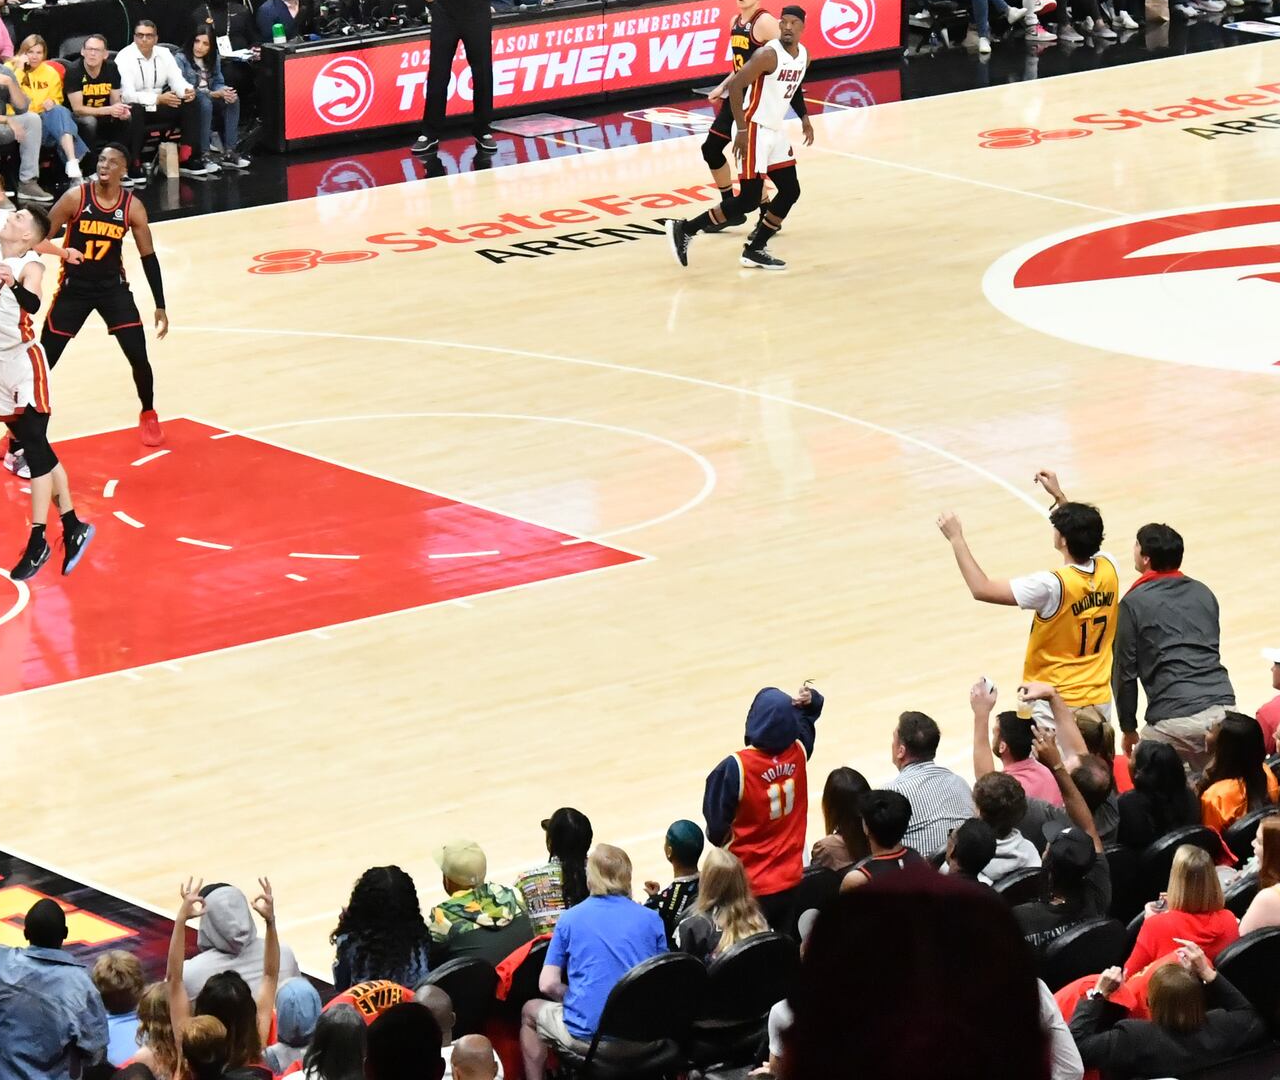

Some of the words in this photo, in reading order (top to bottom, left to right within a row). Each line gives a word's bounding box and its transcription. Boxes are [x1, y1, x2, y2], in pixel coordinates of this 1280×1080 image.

[544, 22, 609, 48] TICKET
[612, 7, 721, 38] MEMBERSHIP
[647, 28, 722, 74] WE
[81, 83, 113, 96] HAWKS
[776, 67, 803, 82] HEAT
[78, 220, 125, 239] HAWKS
[366, 207, 599, 253] State
[474, 217, 677, 265] AREN
[84, 240, 112, 261] 17
[1071, 590, 1115, 617] OKONGWU
[1079, 614, 1108, 659] 17
[760, 762, 796, 784] YOUNG
[766, 776, 795, 818] 11
